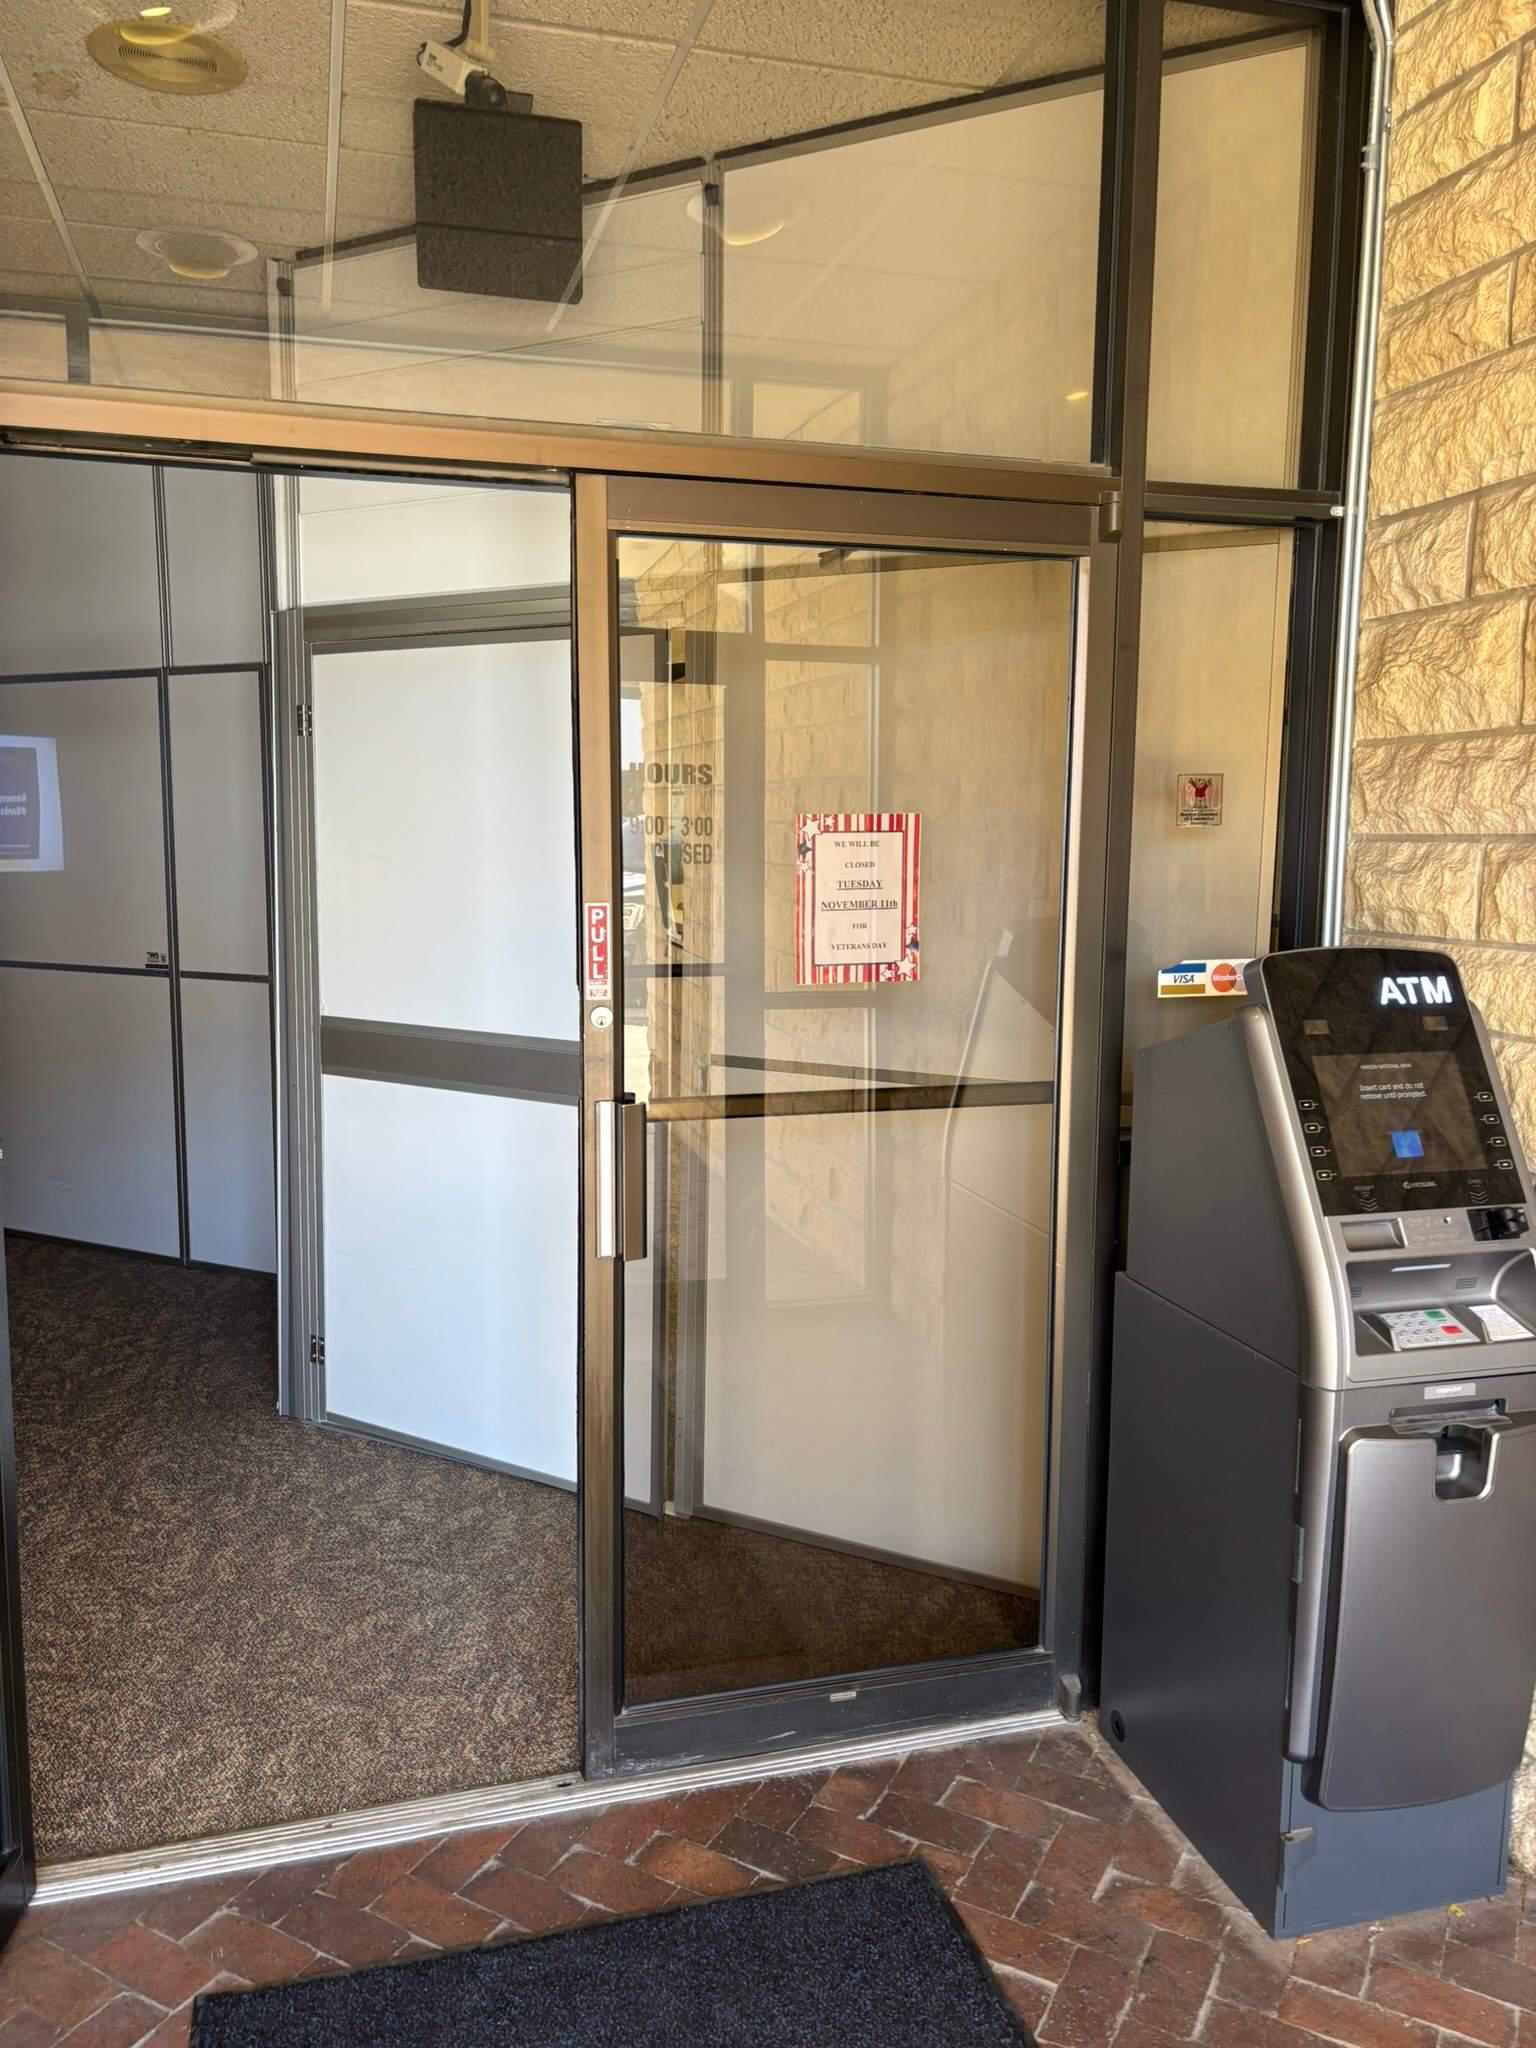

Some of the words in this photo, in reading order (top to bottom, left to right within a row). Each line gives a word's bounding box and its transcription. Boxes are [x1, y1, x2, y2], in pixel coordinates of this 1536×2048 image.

[869, 840, 881, 848] BE
[844, 861, 876, 869] CLOSED
[837, 879, 883, 890] TUESDAY
[821, 900, 878, 910] NOVEMBER
[880, 899, 898, 909] 11th
[591, 908, 605, 979] PULL
[831, 943, 871, 951] VETERANS
[871, 942, 888, 950] DAY
[1173, 974, 1195, 984] VISA
[1213, 973, 1244, 982] MasterC
[1380, 975, 1453, 1005] ATM
[1378, 1083, 1392, 1091] card
[1392, 1083, 1404, 1091] and
[1404, 1082, 1413, 1090] do
[1413, 1082, 1425, 1090] not
